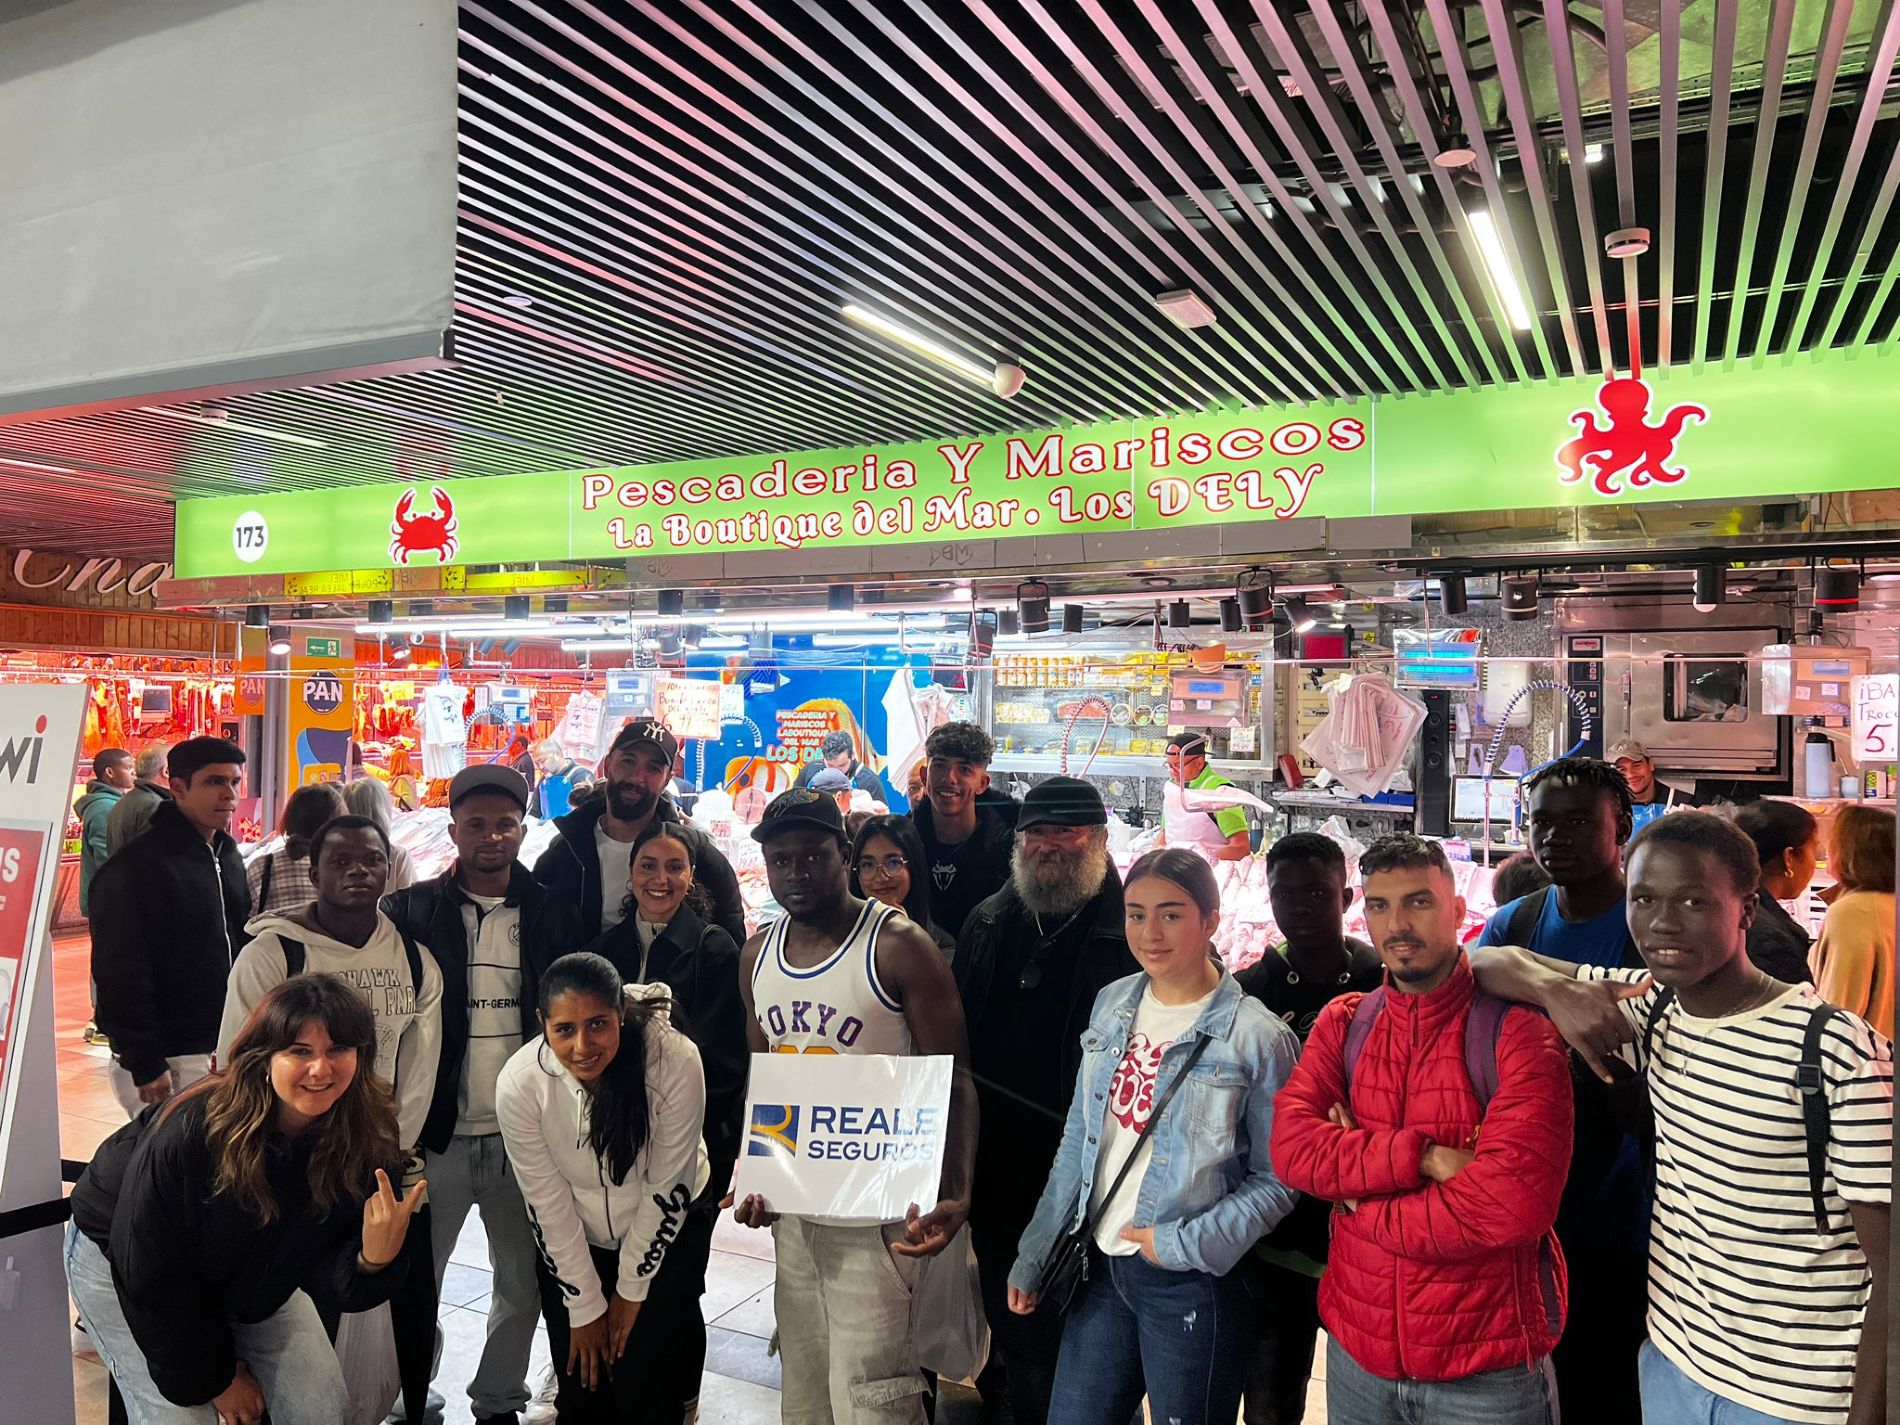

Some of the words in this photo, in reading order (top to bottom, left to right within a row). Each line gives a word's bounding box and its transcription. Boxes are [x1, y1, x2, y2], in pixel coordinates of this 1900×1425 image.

[582, 454, 918, 510] Pescaderia
[937, 442, 984, 484] Y
[1005, 418, 1366, 480] Mariscos
[607, 517, 654, 549] La
[662, 510, 843, 549] Boutique
[853, 496, 913, 536] del
[1049, 485, 1135, 524] Los
[1148, 463, 1324, 519] DELY
[236, 525, 265, 548] 173
[829, 711, 836, 719] Y
[801, 738, 819, 746] MAR
[767, 746, 798, 762] LOS
[758, 1000, 864, 1047] OKYO
[810, 1105, 938, 1136] REALE
[807, 1140, 934, 1161] SEGUROS
